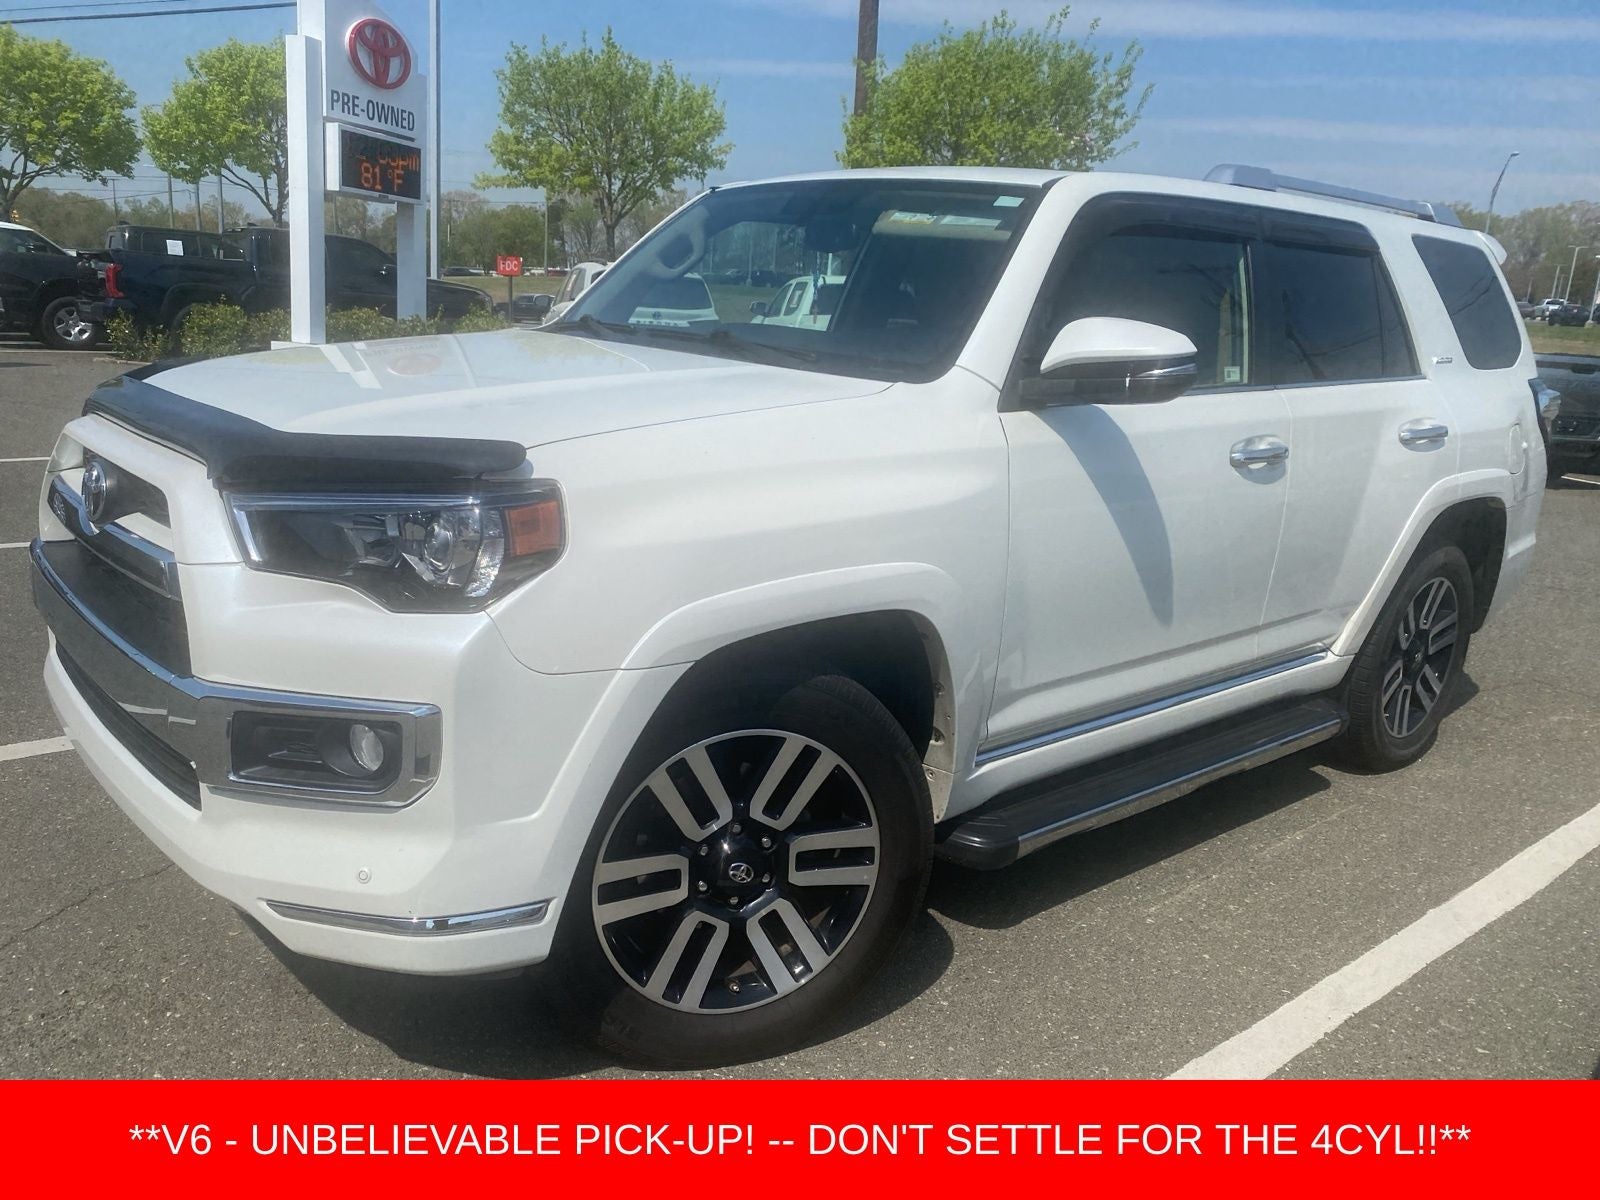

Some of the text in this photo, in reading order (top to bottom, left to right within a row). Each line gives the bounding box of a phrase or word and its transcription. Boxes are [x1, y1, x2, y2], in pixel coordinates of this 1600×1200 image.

[330, 89, 415, 131] PRE-OWNED
[360, 162, 382, 190] 81
[500, 260, 518, 271] FDC
